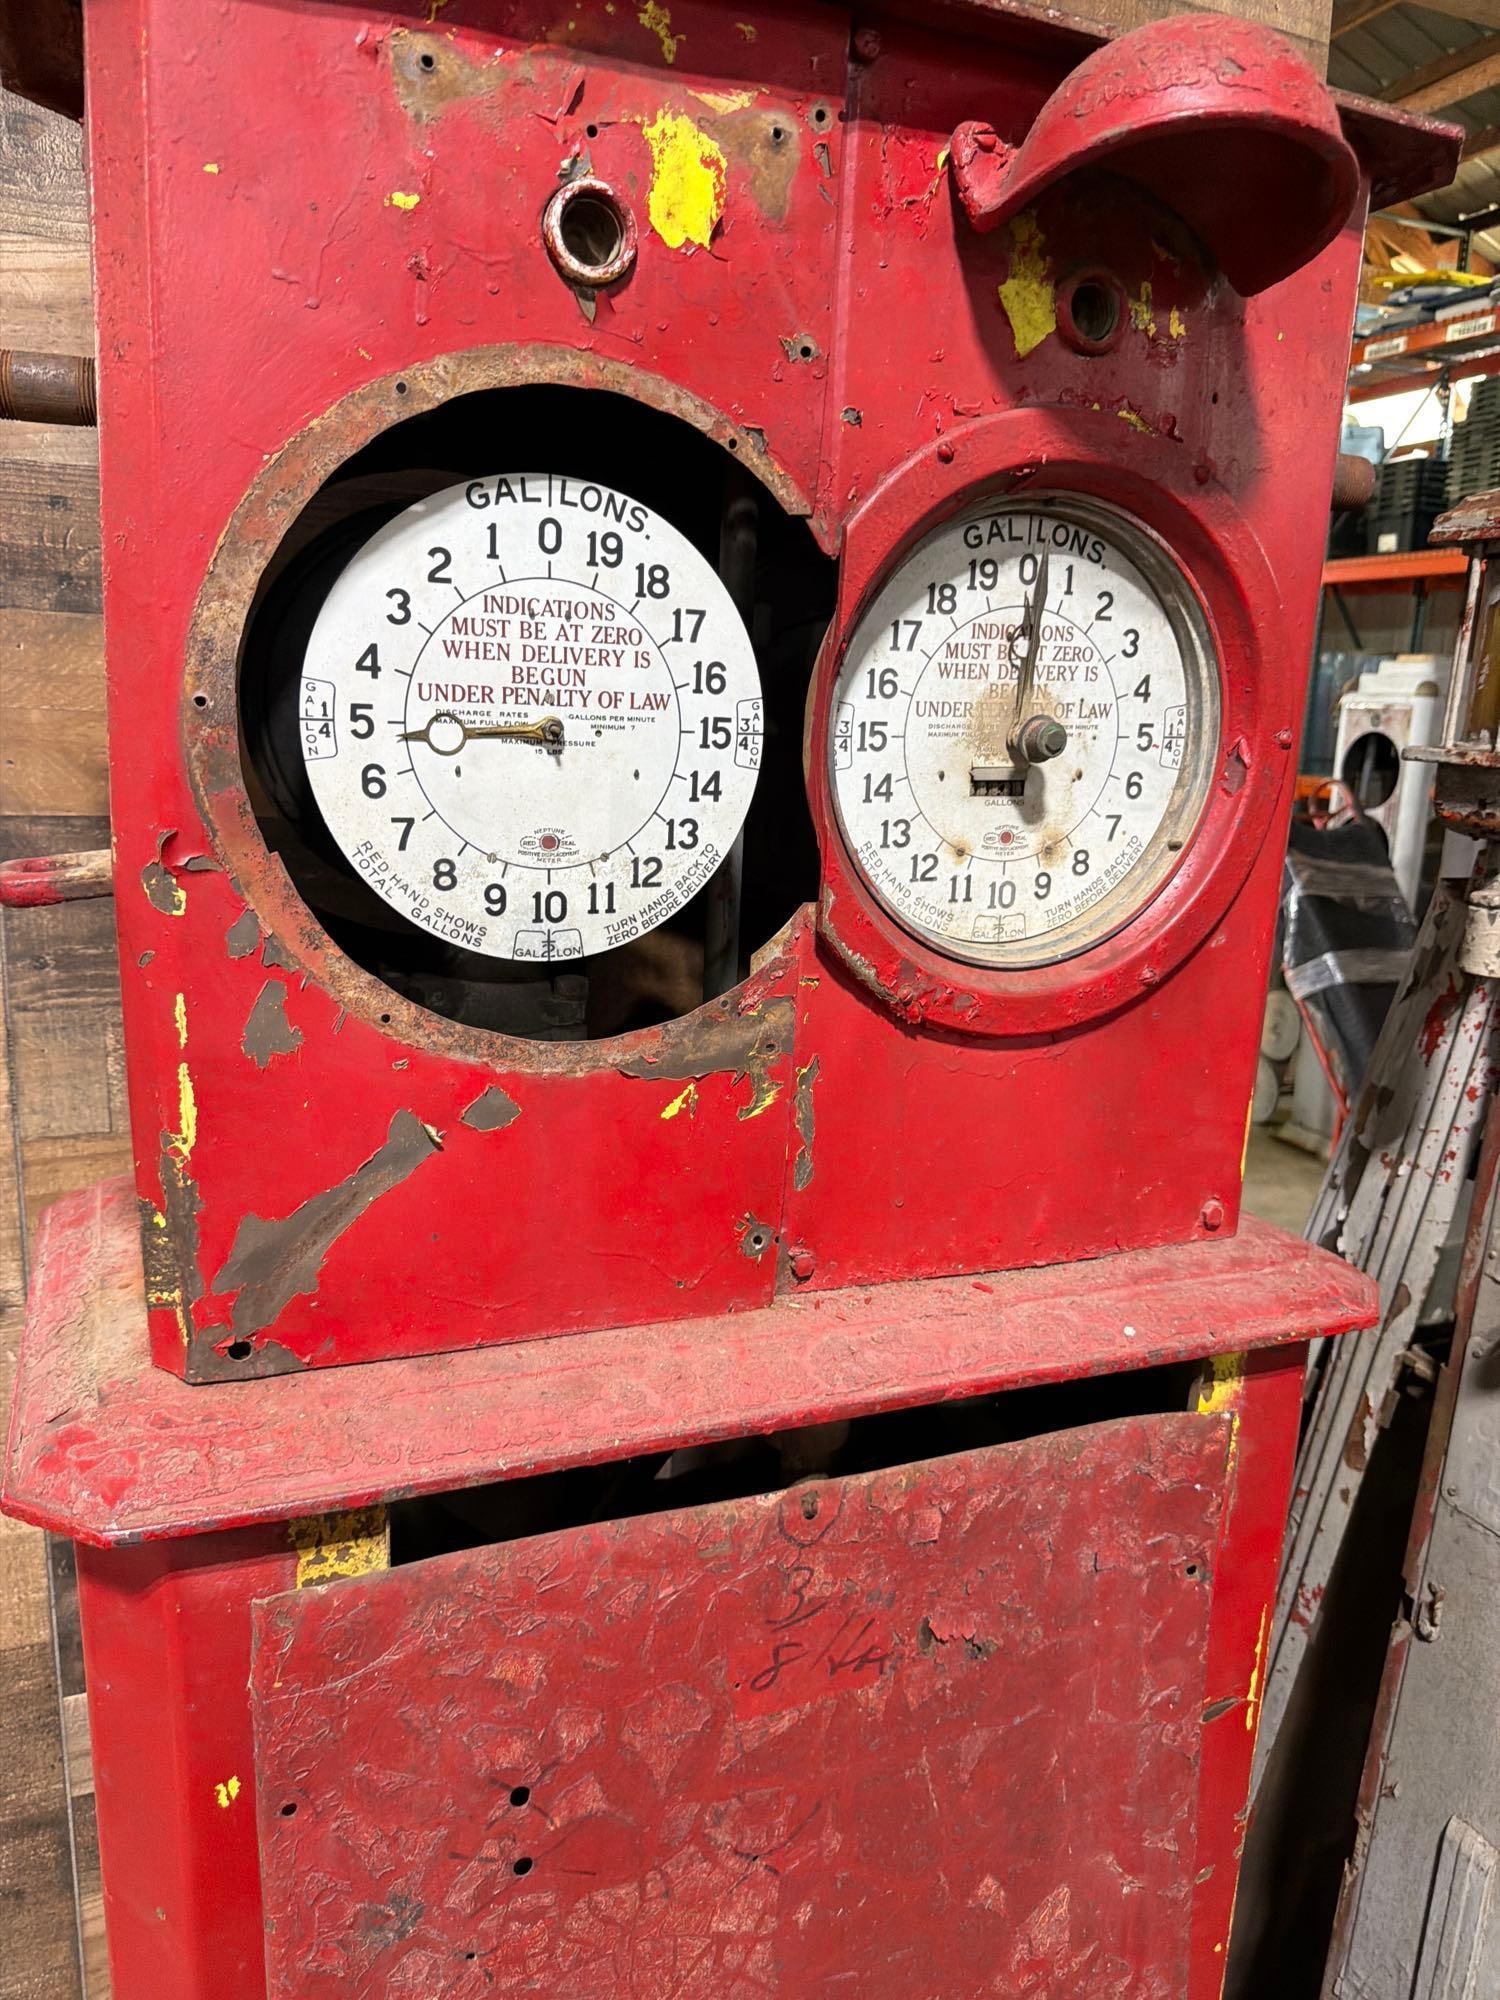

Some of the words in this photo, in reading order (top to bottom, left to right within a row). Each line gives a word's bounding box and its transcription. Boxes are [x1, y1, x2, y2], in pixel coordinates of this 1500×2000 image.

[486, 522, 499, 559] 1
[538, 517, 562, 555] 0
[586, 531, 623, 569] 19
[427, 546, 452, 584] 2
[635, 562, 670, 600] 18
[967, 558, 998, 591] 19
[1019, 553, 1038, 585] 0
[1064, 564, 1074, 596] 1
[386, 588, 412, 626] 3
[483, 595, 616, 621] INDICATIONS
[926, 582, 957, 615] 18
[1095, 590, 1114, 621] 2
[451, 616, 510, 638] MUST
[519, 621, 547, 641] BE
[556, 624, 583, 642] AT
[591, 626, 643, 646] ZERO
[672, 609, 706, 643] 17
[889, 620, 922, 652] 17
[442, 639, 510, 662] WHEN
[522, 645, 625, 668] DELIVERY
[634, 651, 651, 669] IS
[945, 643, 992, 660] MUST
[1053, 646, 1094, 663] ZERO
[1121, 628, 1139, 658] 3
[355, 643, 381, 679] 4
[511, 666, 586, 687] BEGUN
[937, 662, 990, 680] WHEN
[997, 664, 1079, 682] DEVERY
[1084, 666, 1098, 682] IS
[693, 662, 727, 694] 16
[866, 668, 898, 699] 16
[1133, 674, 1150, 703] 4
[417, 682, 493, 704] UNDER
[502, 687, 592, 708] PENALTY
[598, 692, 624, 710] OF
[629, 692, 671, 712] LAW
[435, 709, 492, 717] DISCHARGE
[915, 701, 973, 718] UNDER
[1054, 702, 1075, 718] OF
[1078, 702, 1113, 719] LAW
[350, 703, 375, 739] 5
[699, 716, 732, 750] 15
[857, 721, 888, 752] 15
[1136, 723, 1154, 752] 5
[361, 763, 387, 799] 6
[689, 770, 722, 802] 14
[862, 773, 894, 803] 14
[1125, 771, 1142, 799] 6
[984, 799, 1024, 807] GALLONS
[391, 817, 416, 851] 7
[665, 818, 698, 850] 13
[879, 819, 911, 849] 13
[1105, 814, 1122, 841] 7
[432, 858, 458, 891] 8
[630, 857, 663, 888] 12
[909, 853, 939, 883] 12
[1044, 899, 1071, 918] TURN
[1073, 876, 1104, 903] HANDS
[1104, 849, 1128, 878] BACK
[1126, 835, 1139, 849] TO
[1072, 849, 1090, 876] 8
[352, 847, 393, 899] TOTAL
[410, 907, 483, 947] GALLONS
[360, 840, 389, 872] RED
[389, 873, 430, 909] HAND
[433, 907, 488, 937] SHOWS
[603, 914, 638, 935] TURN
[639, 889, 675, 919] HANDS
[674, 859, 704, 890] BACK
[700, 843, 714, 860] TO
[606, 926, 639, 946] ZERO
[641, 896, 682, 929] BEFORE
[681, 849, 721, 899] DELIVERY
[862, 840, 883, 868] RED
[882, 868, 912, 898] HAND
[913, 896, 955, 923] SHOWS
[949, 875, 972, 903] 11
[988, 881, 1015, 909] 10
[1034, 872, 1052, 900] 9
[1046, 910, 1072, 928] ZERO
[1075, 882, 1109, 913] BEFORE
[1109, 840, 1144, 886] DELIVERY
[484, 884, 507, 916] 9
[532, 891, 567, 924] 10
[587, 882, 616, 914] 11
[896, 897, 949, 932] GALLONS
